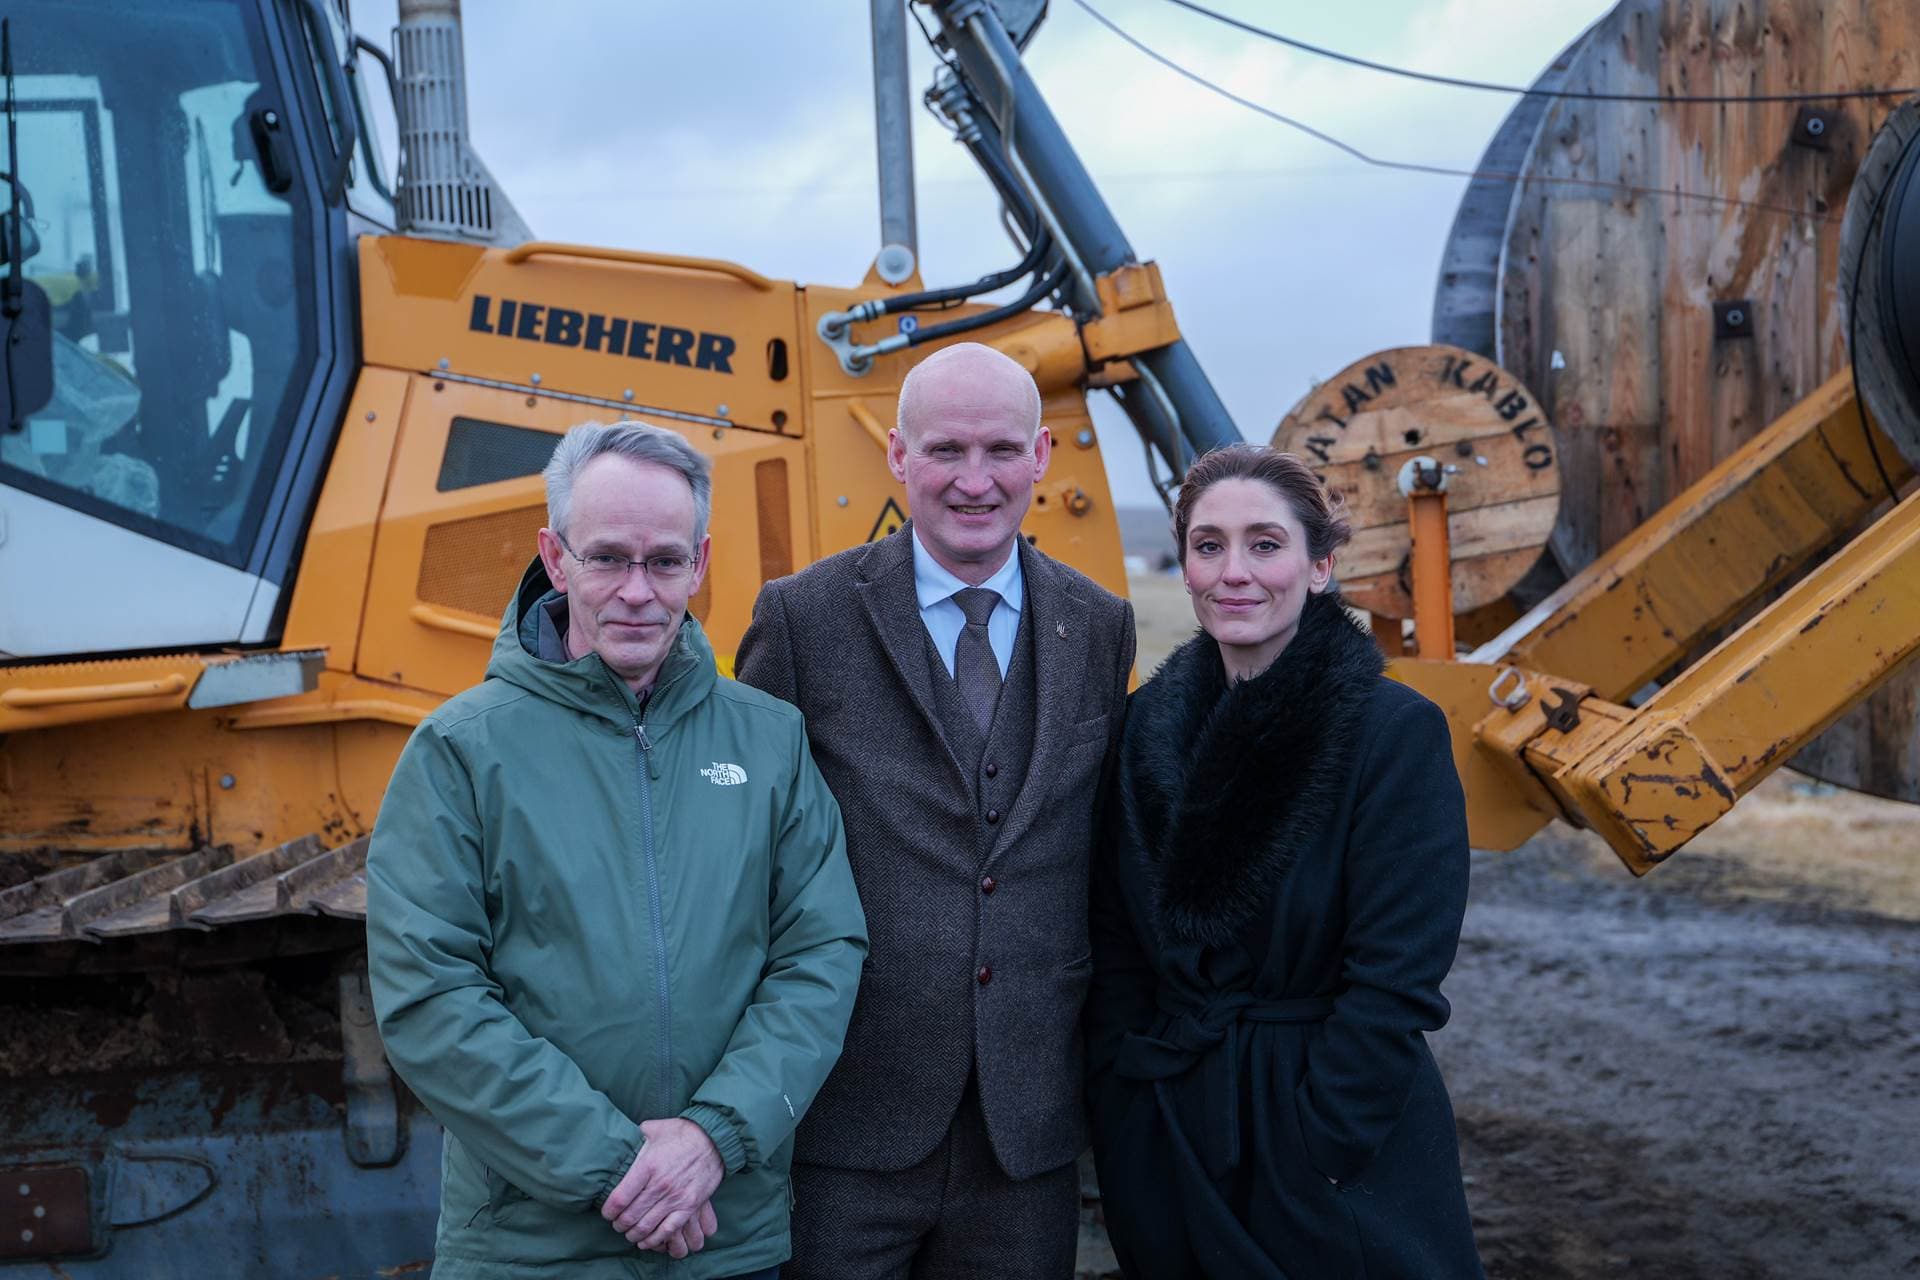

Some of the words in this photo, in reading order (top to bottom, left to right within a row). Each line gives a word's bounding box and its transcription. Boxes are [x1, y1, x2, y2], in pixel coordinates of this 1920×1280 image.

[469, 294, 736, 375] LIEBHERR
[1305, 362, 1396, 483] ATAN
[1440, 355, 1553, 470] KABLO
[712, 761, 728, 770] THE
[700, 768, 729, 778] NORTH
[711, 776, 731, 785] FACE
